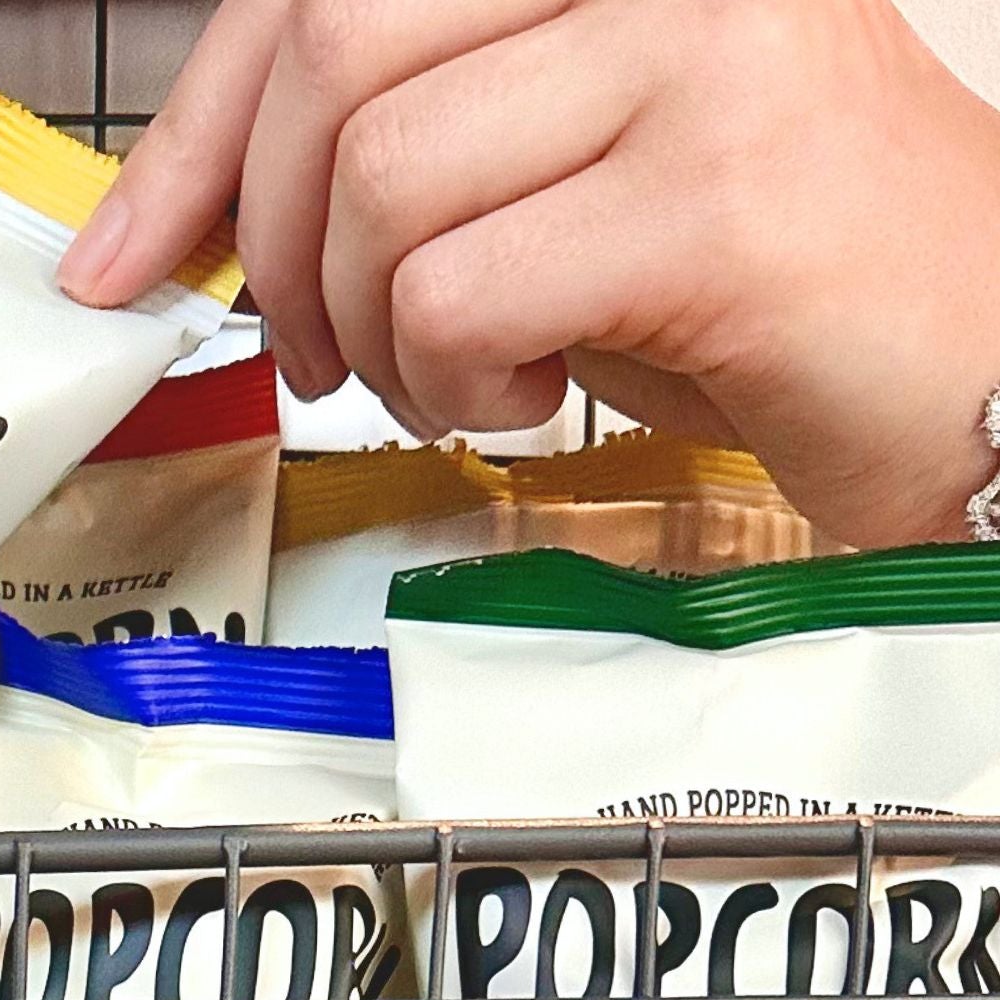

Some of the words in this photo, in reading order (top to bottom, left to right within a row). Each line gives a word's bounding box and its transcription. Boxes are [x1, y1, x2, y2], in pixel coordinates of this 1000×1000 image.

[24, 583, 50, 603] IN
[56, 583, 74, 601] A
[80, 570, 174, 599] KETTLE
